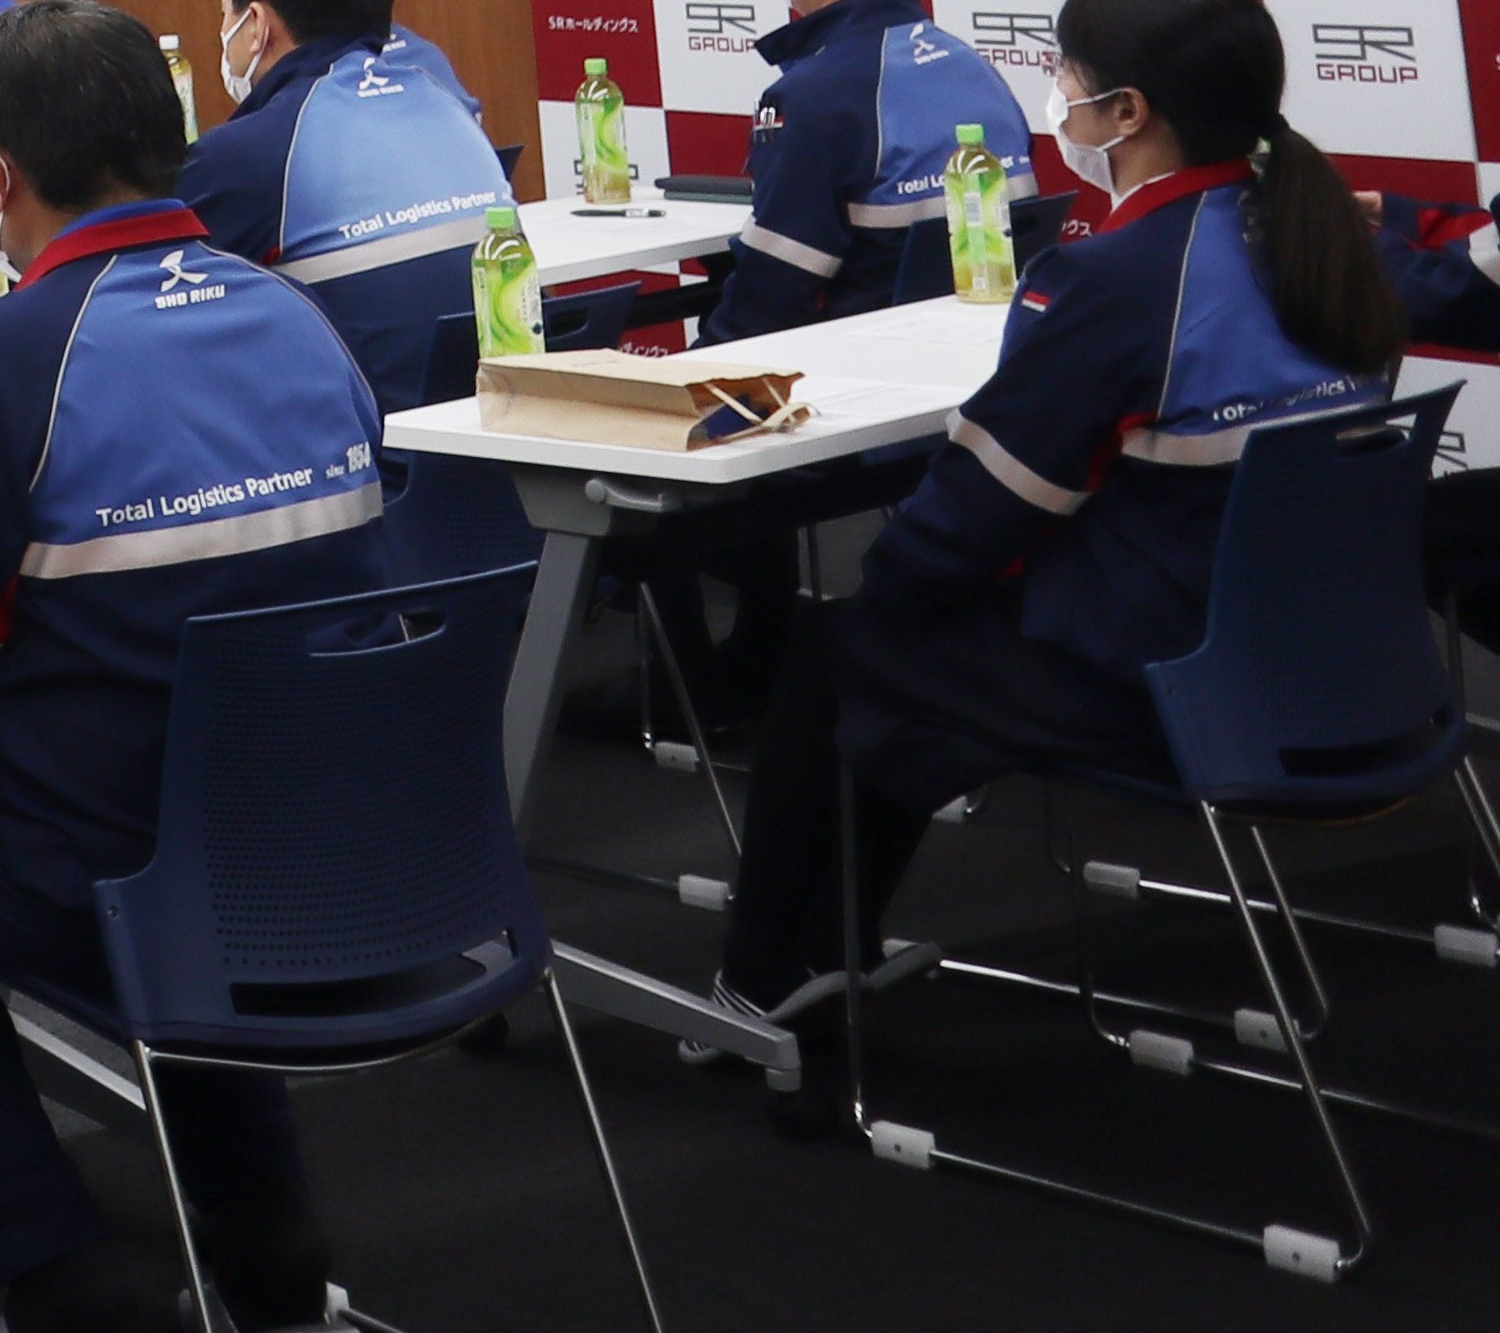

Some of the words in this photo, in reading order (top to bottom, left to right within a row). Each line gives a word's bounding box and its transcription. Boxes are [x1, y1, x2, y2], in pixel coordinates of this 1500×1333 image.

[548, 15, 639, 33] SRホールディングス
[1317, 64, 1418, 84] GROUP
[897, 175, 929, 195] Total
[340, 216, 384, 241] Total
[386, 201, 449, 231] Logistics
[452, 189, 497, 215] Partner
[156, 290, 190, 310] SHO
[192, 282, 226, 304] RIKU
[97, 497, 155, 528] Total
[159, 482, 244, 519] Logistics
[247, 466, 313, 499] Partner
